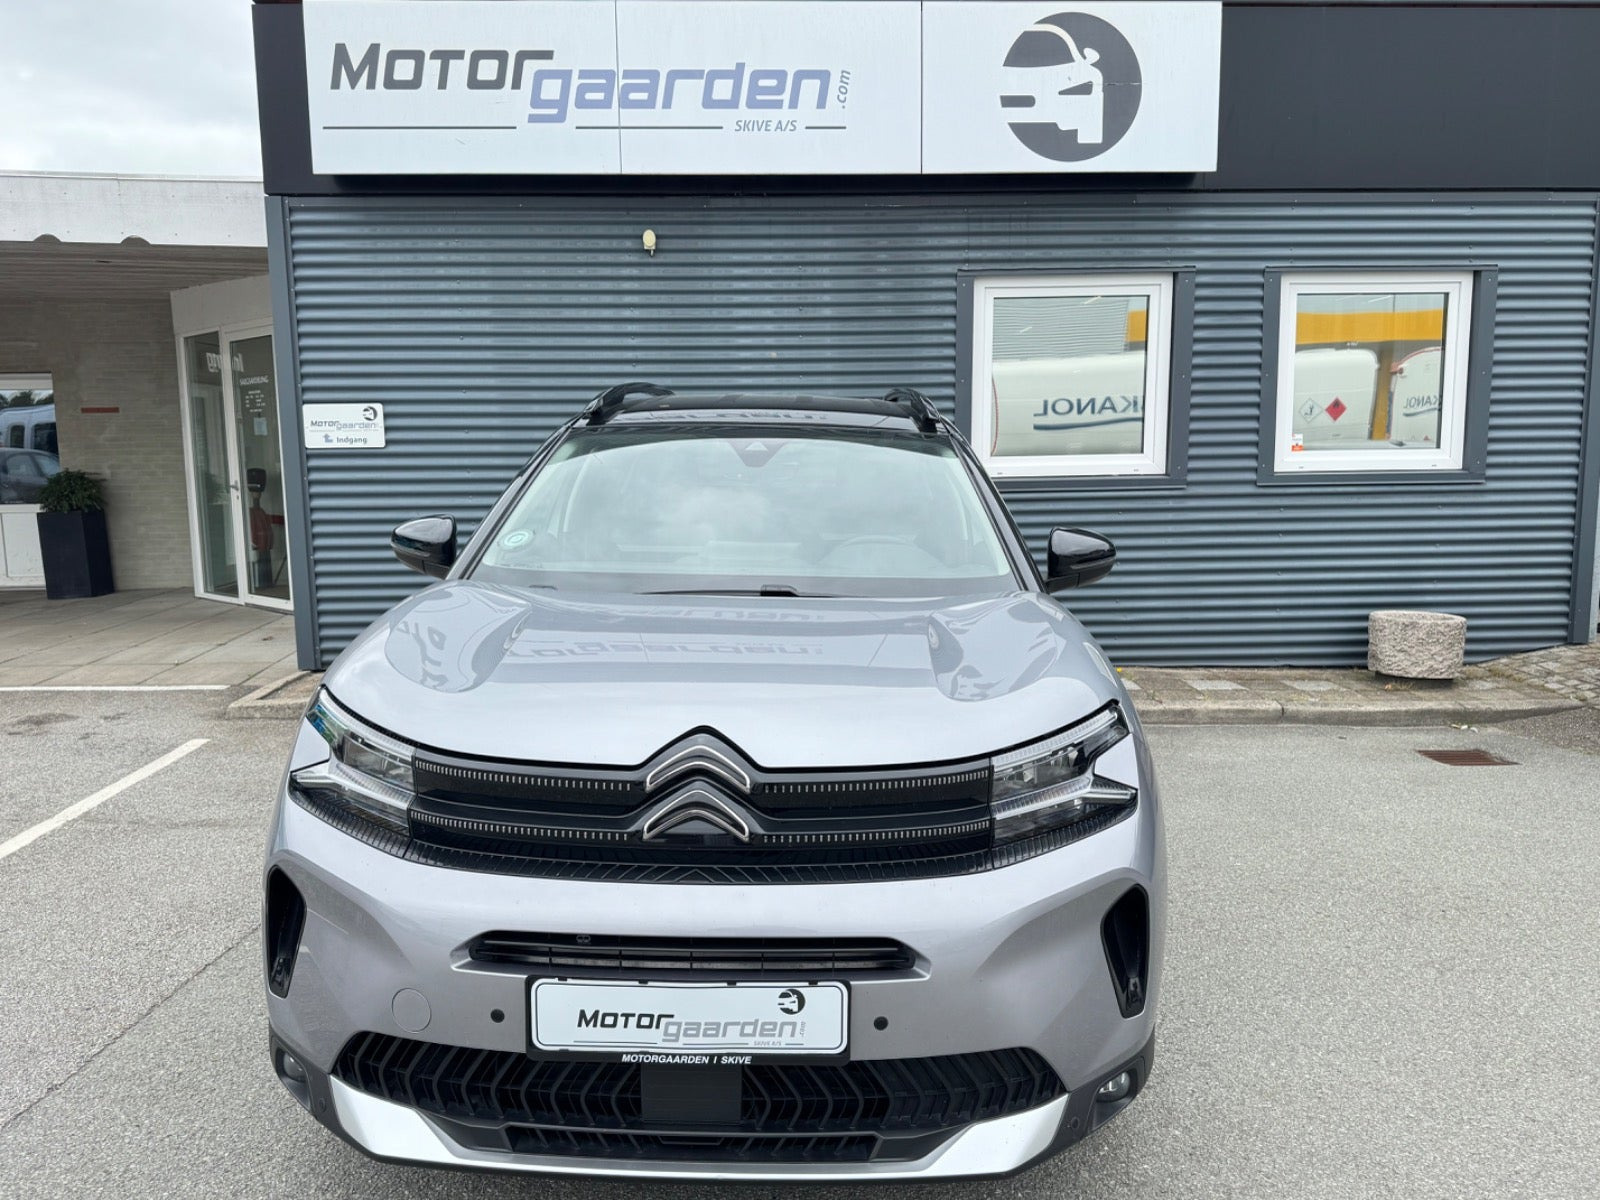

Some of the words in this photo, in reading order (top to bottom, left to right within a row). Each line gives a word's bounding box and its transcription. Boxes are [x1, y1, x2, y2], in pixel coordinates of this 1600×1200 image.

[837, 70, 851, 109] .com
[734, 119, 772, 132] SKIVE
[774, 119, 797, 132] A/S
[336, 436, 367, 444] Indgang
[621, 1053, 709, 1064] MOTORGAARDEN
[721, 1056, 752, 1065] SKIVE
